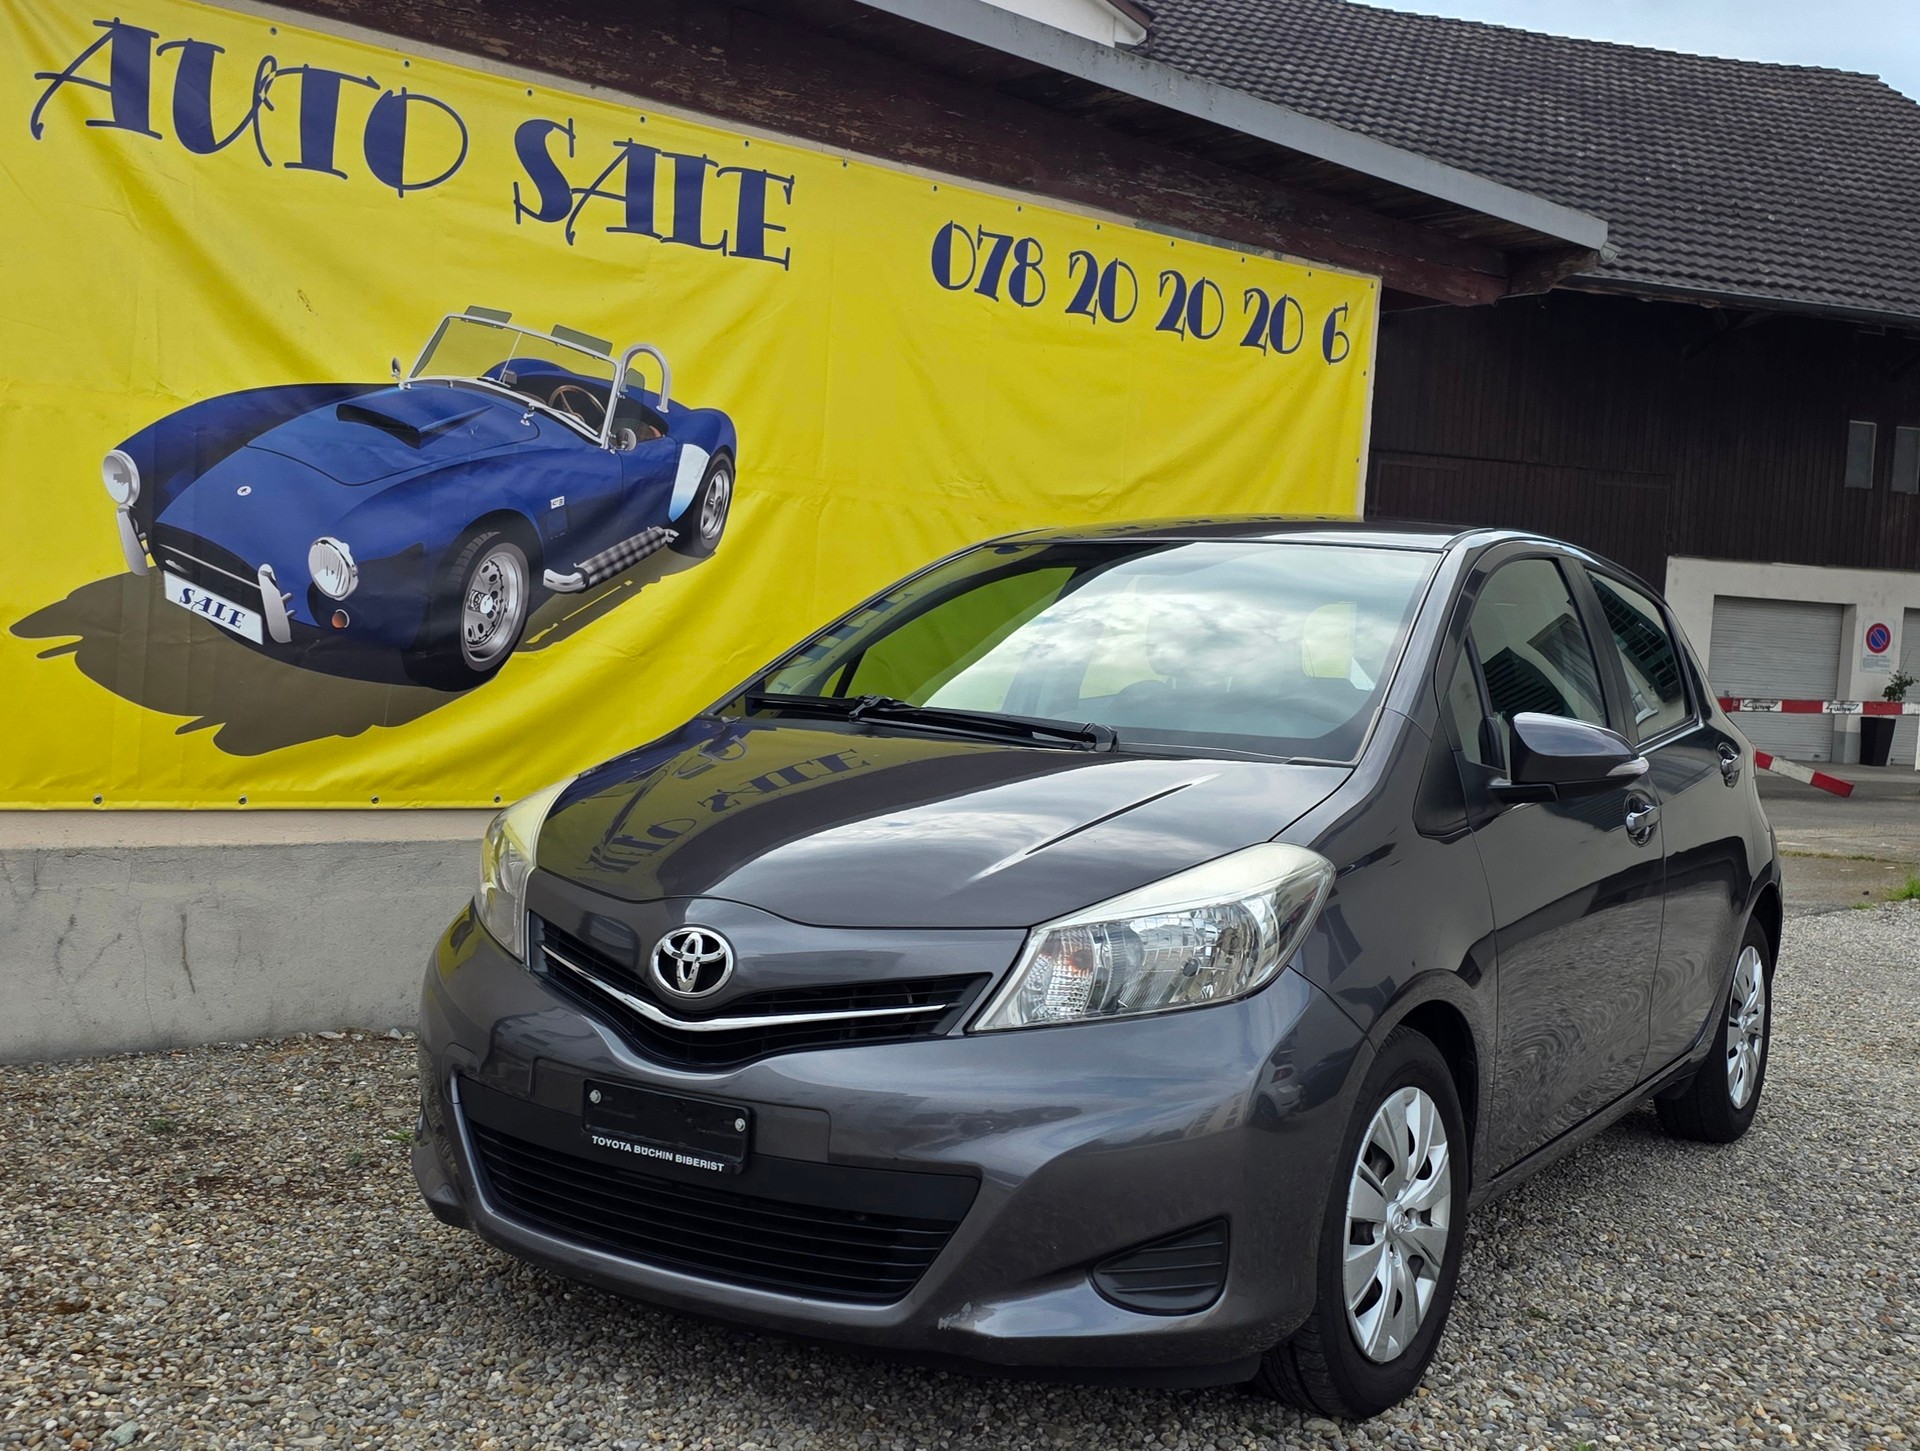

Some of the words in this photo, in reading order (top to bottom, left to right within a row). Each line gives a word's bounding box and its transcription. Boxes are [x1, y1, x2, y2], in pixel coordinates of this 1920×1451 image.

[31, 17, 469, 198] AUTO
[513, 117, 796, 271] SALE
[930, 219, 1047, 308] 078
[1064, 249, 1139, 325] 20
[1155, 269, 1225, 342] 20
[1239, 287, 1304, 357] 20
[1321, 301, 1351, 366] 6
[179, 587, 246, 629] SALE
[592, 1135, 632, 1152] TOYOTA
[675, 1154, 725, 1172] BIBERIST
